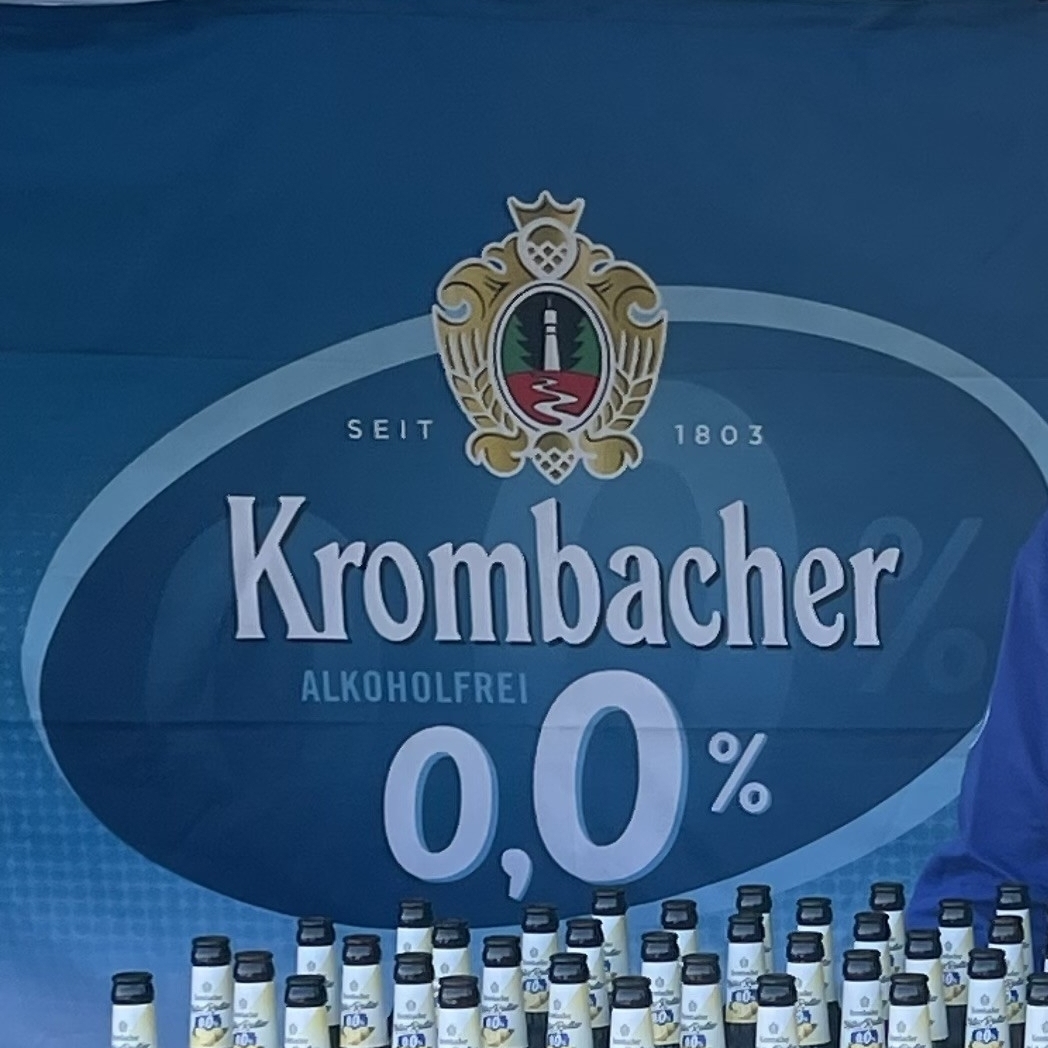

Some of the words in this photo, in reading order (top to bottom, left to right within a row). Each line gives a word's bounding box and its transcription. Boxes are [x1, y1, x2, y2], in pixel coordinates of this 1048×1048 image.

[347, 418, 434, 441] SEIT
[673, 423, 764, 447] 1803
[227, 493, 901, 649] Krombacher
[301, 668, 529, 705] ALKOHOLFREI
